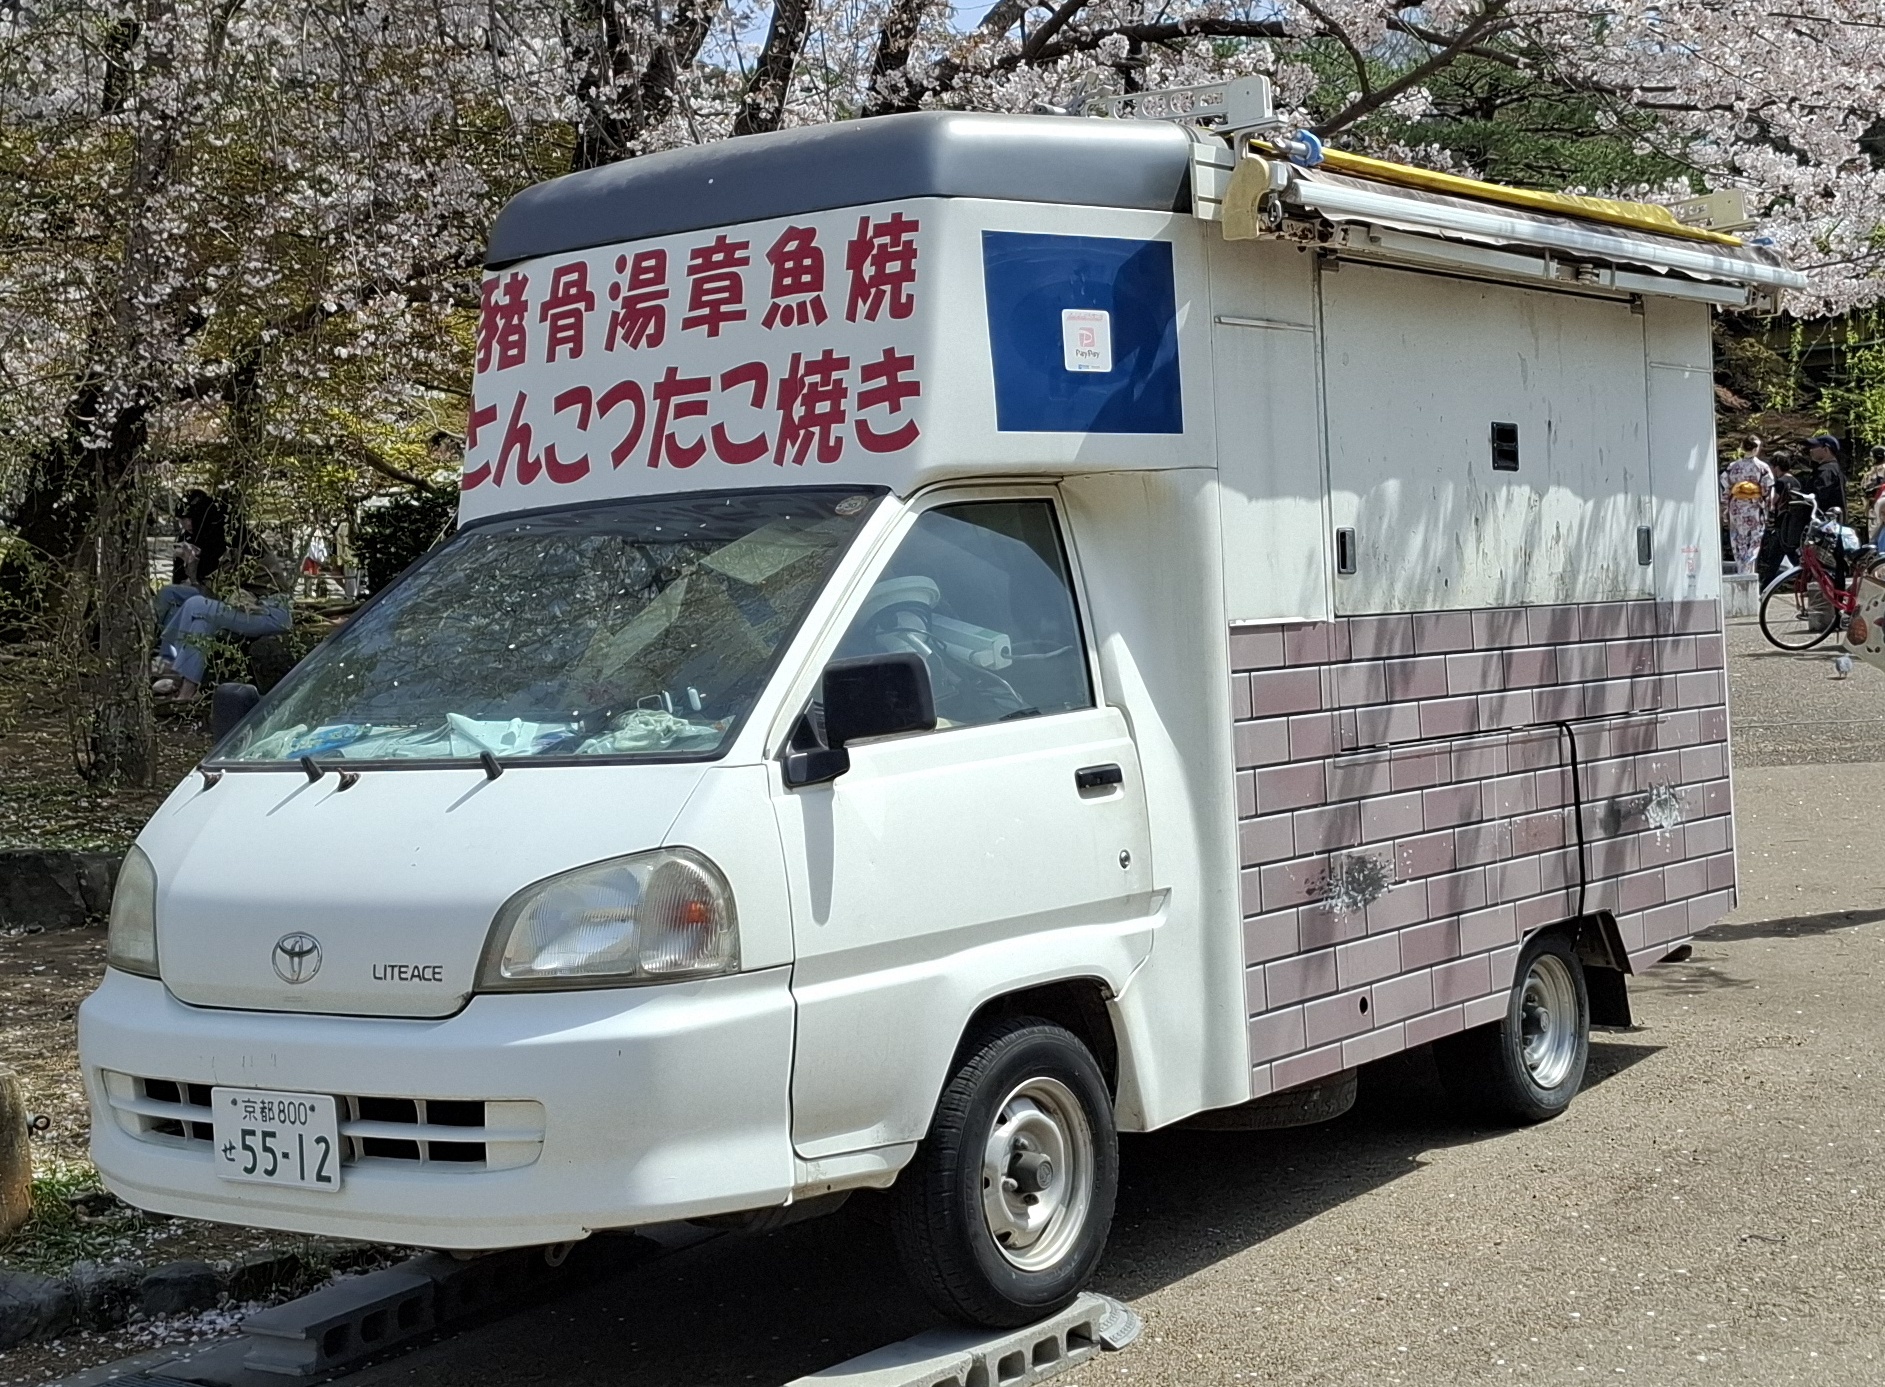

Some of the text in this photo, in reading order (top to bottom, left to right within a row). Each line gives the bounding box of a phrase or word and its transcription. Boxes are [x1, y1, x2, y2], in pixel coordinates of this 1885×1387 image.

[1075, 349, 1100, 358] PayPay
[373, 964, 443, 982] LITEACE
[221, 1139, 236, 1162] せ
